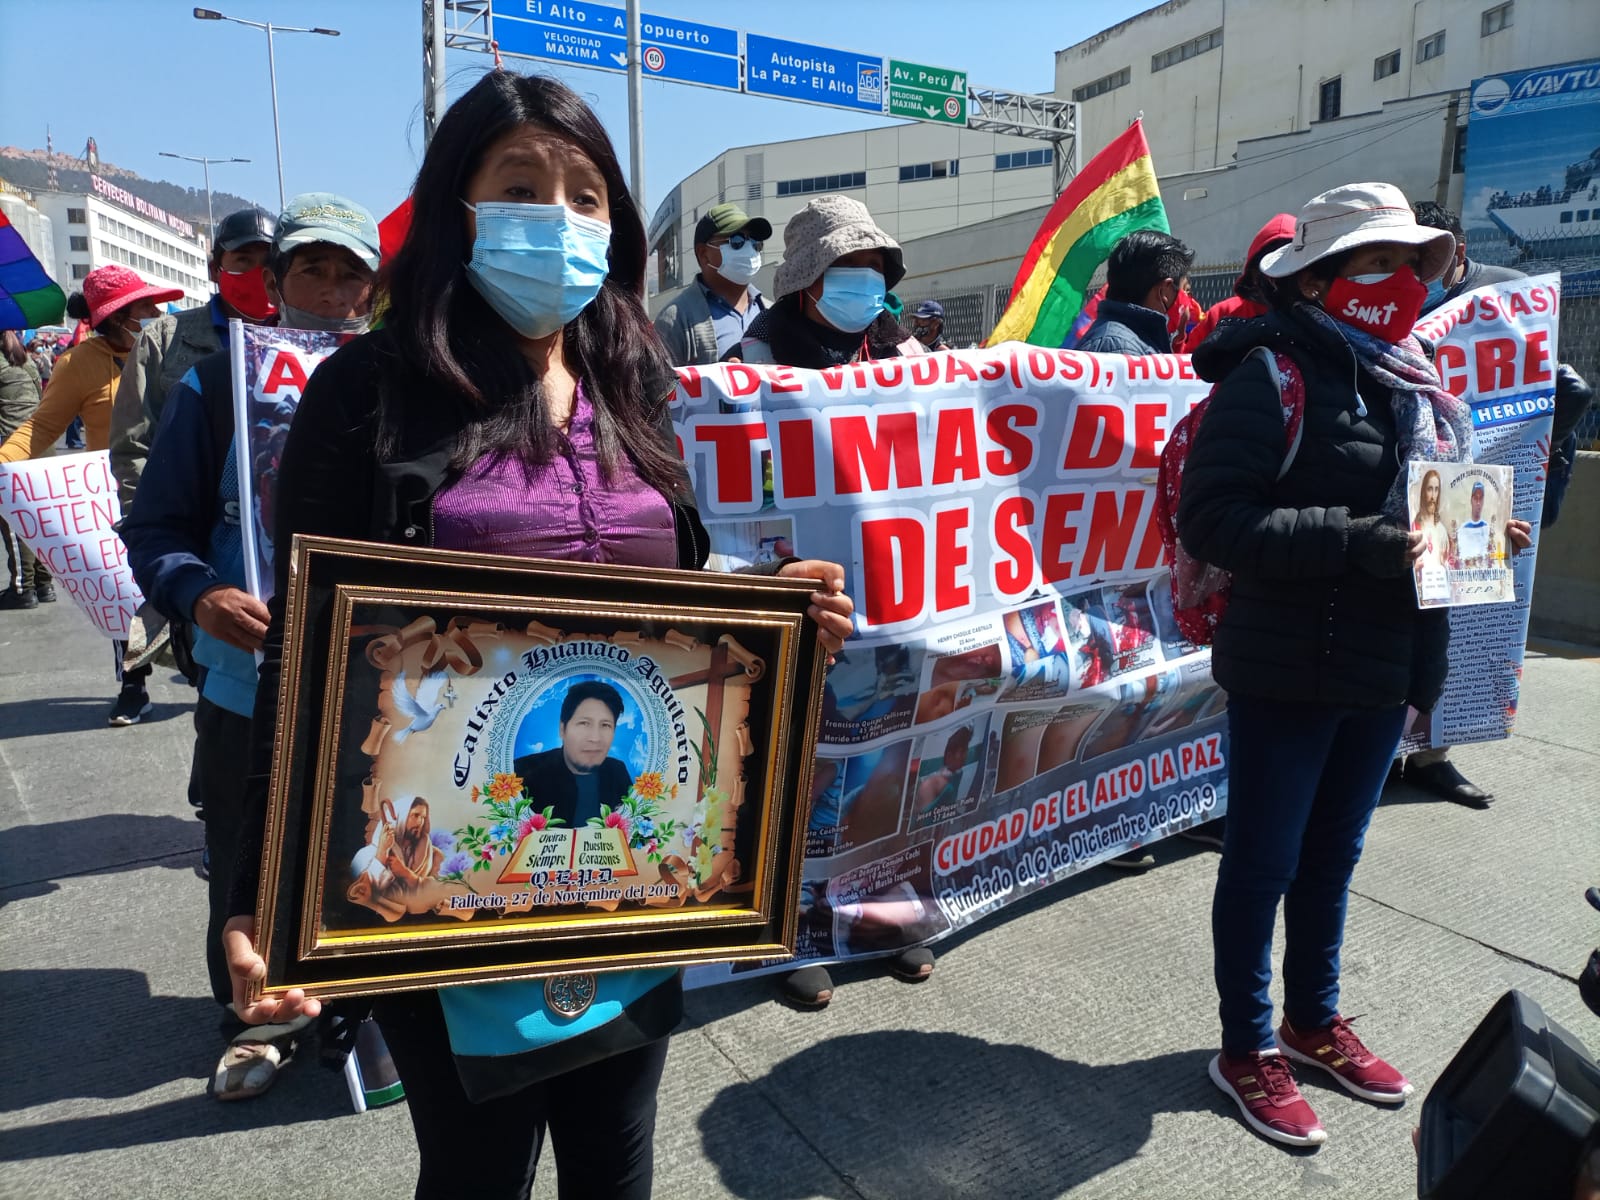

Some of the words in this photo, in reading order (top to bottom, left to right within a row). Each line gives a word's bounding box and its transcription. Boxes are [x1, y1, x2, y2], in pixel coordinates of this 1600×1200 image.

[526, 0, 542, 14] El
[550, 2, 586, 22] Alto
[613, 16, 710, 44] Aopuerto
[543, 31, 601, 48] VELOCIDAD
[546, 42, 599, 60] MAXIMA
[649, 53, 660, 64] 60
[771, 52, 836, 75] Autopista
[751, 66, 767, 80] La
[772, 69, 797, 85] Paz
[811, 76, 824, 90] El
[829, 79, 854, 95] Alto
[859, 75, 880, 90] ABC
[894, 67, 914, 81] Av.
[919, 71, 948, 86] Perú
[1517, 68, 1600, 99] NAVTU
[891, 91, 924, 101] VELOCIDAD
[891, 98, 922, 111] MAXIMA
[262, 351, 320, 394] A
[720, 365, 803, 398] DE
[1122, 353, 1201, 381] HUE
[676, 404, 1039, 504] TIMAS
[1063, 402, 1167, 471] DE
[0, 456, 112, 505] FALLECI
[861, 507, 970, 627] DE
[453, 671, 518, 788] Calixto
[522, 640, 630, 674] Huanaco
[937, 813, 1024, 871] CIUDAD
[1032, 797, 1058, 831] DE
[1066, 784, 1087, 817] EL
[1094, 763, 1143, 807] ALTO
[1150, 754, 1176, 786] LA
[1181, 737, 1222, 774] PAZ
[583, 840, 614, 852] Nuestros
[594, 831, 602, 840] en
[540, 844, 558, 855] por
[578, 853, 621, 865] Corazones
[941, 866, 1011, 917] Fundado
[1016, 853, 1033, 882] el
[1036, 853, 1048, 877] 6
[1051, 844, 1069, 864] de
[1071, 815, 1147, 857] Diciembre
[1148, 804, 1167, 828] de
[1169, 785, 1217, 821] 2019
[526, 854, 566, 869] Siempre
[531, 867, 618, 889] Q.E.P.D.
[450, 894, 507, 910] Fallecio:
[512, 892, 529, 906] 27
[533, 891, 550, 904] de
[555, 887, 621, 905] Noviembre
[625, 884, 644, 899] del
[647, 883, 679, 898] 2019
